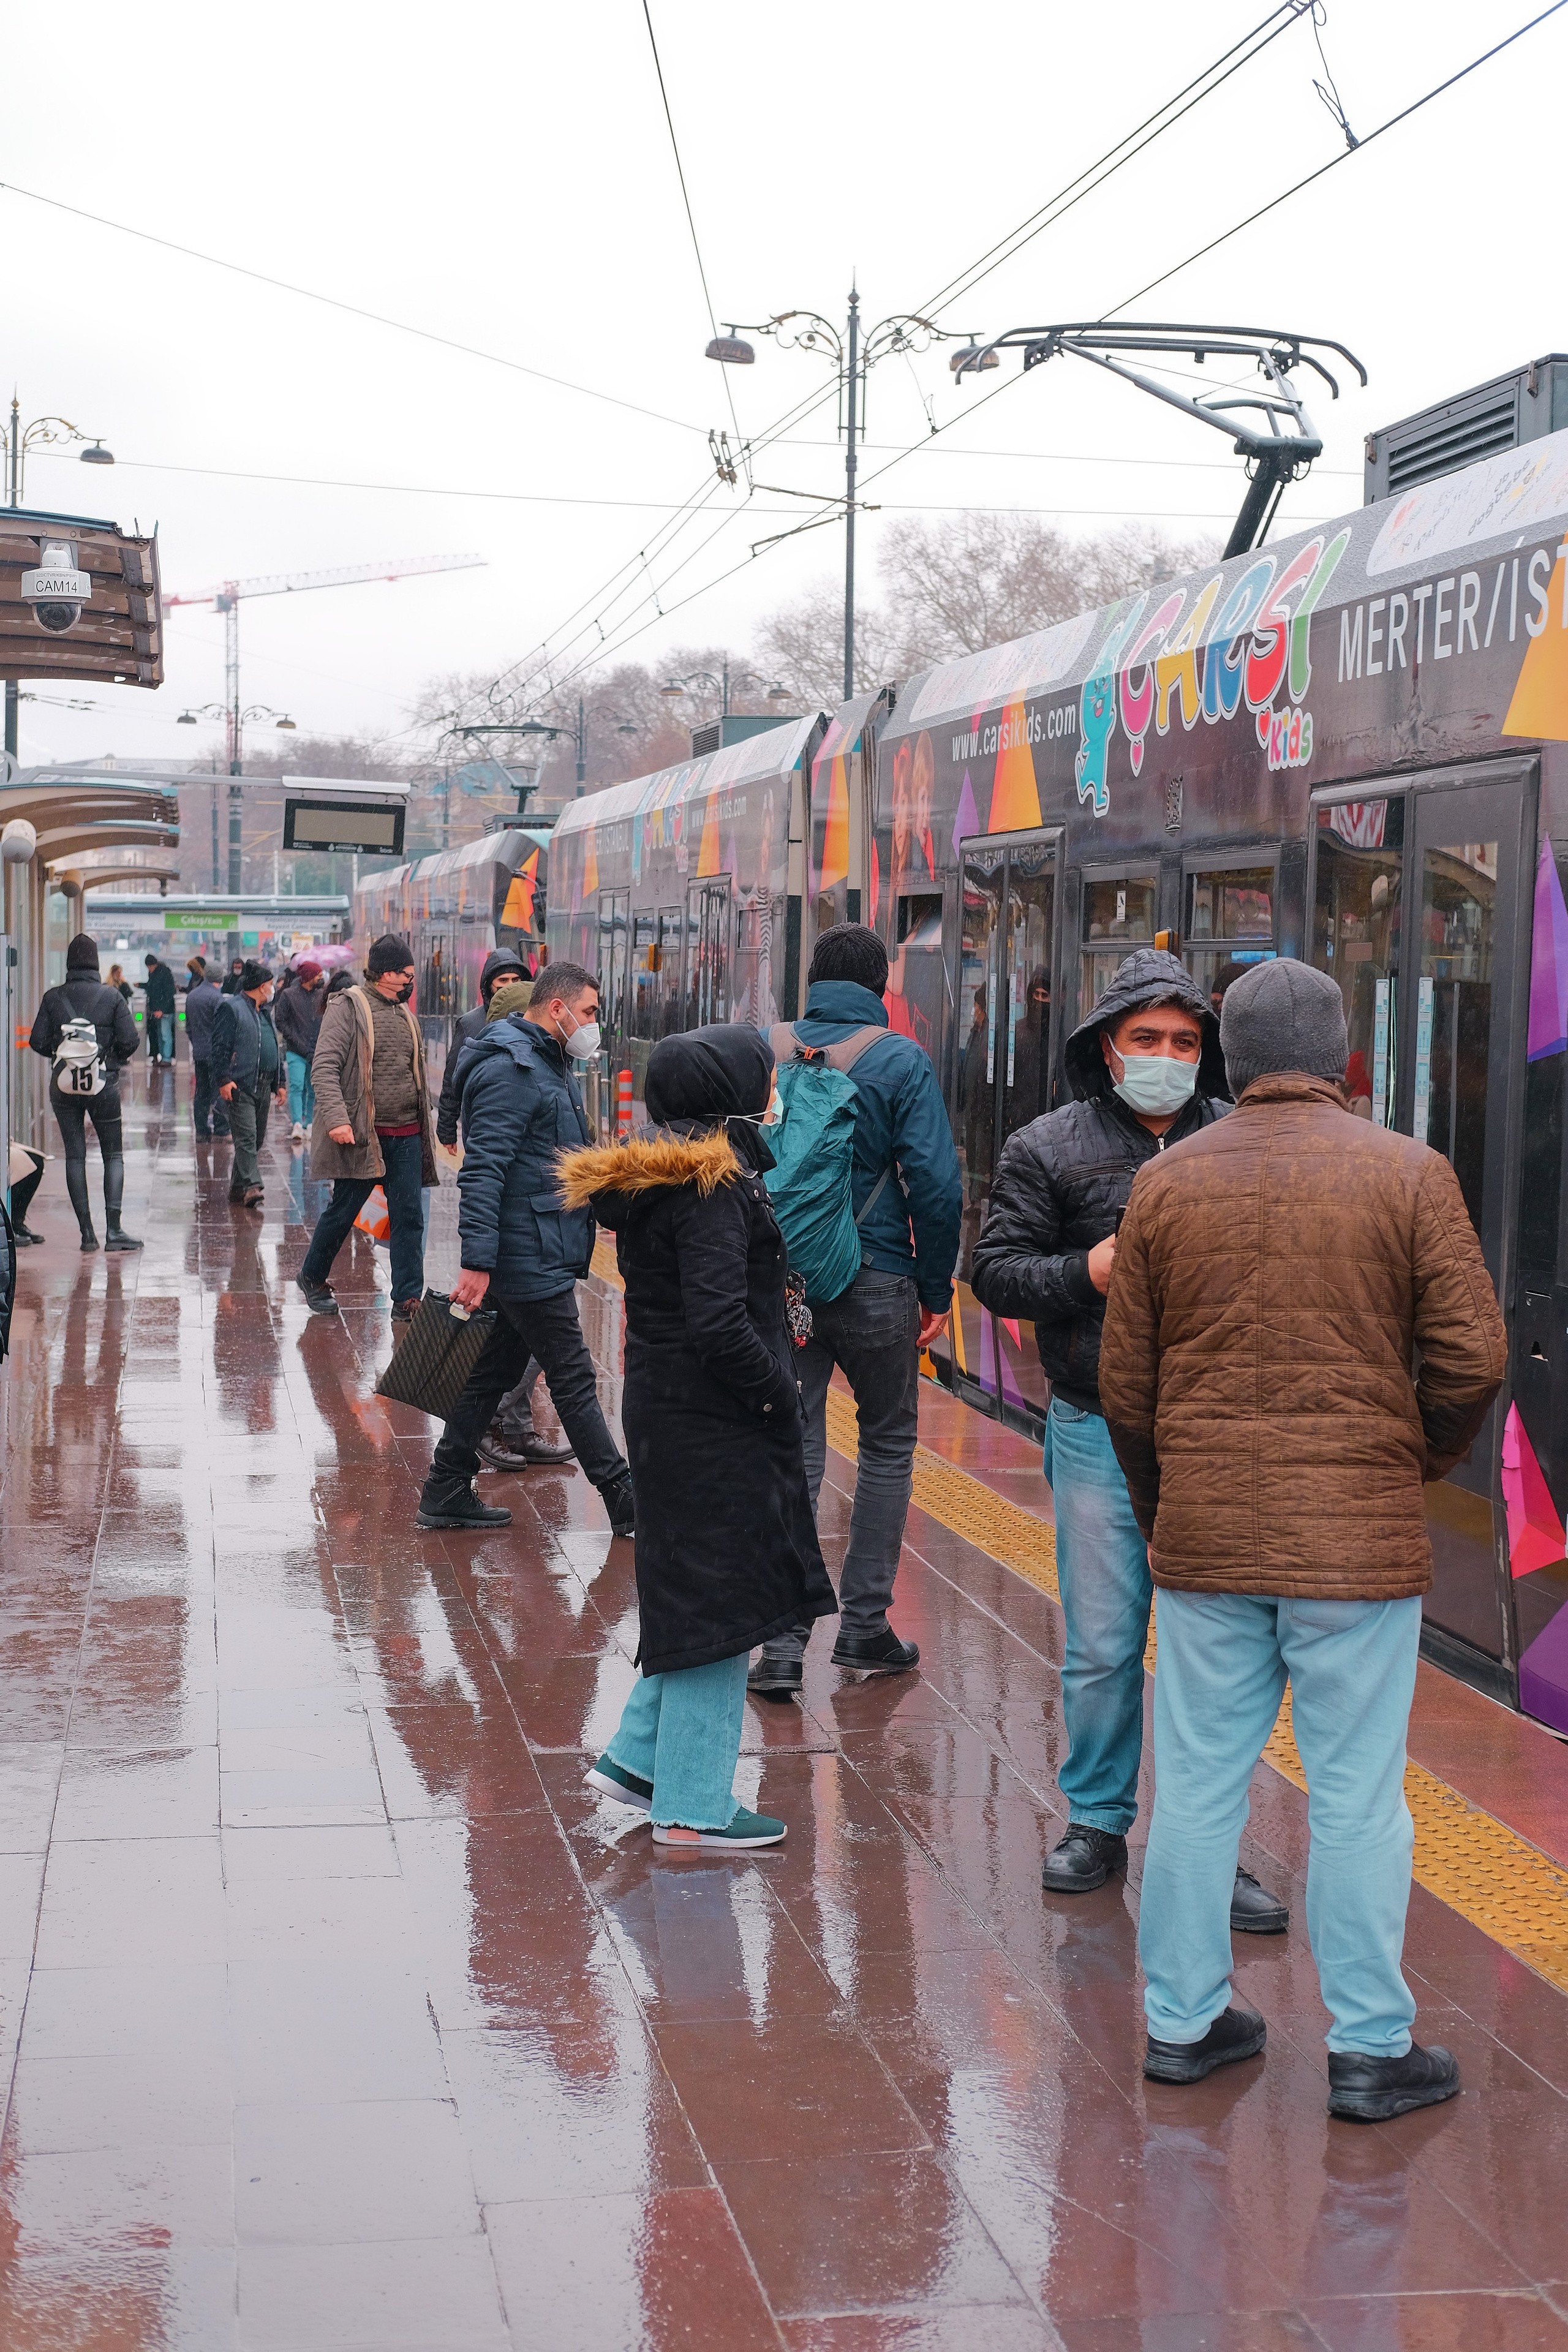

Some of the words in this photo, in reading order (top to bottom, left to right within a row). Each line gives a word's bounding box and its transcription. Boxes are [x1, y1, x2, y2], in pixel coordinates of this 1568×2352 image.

[36, 580, 78, 594] CAM14
[952, 704, 1077, 762] www.carsikids.com
[70, 1066, 92, 1091] 15
